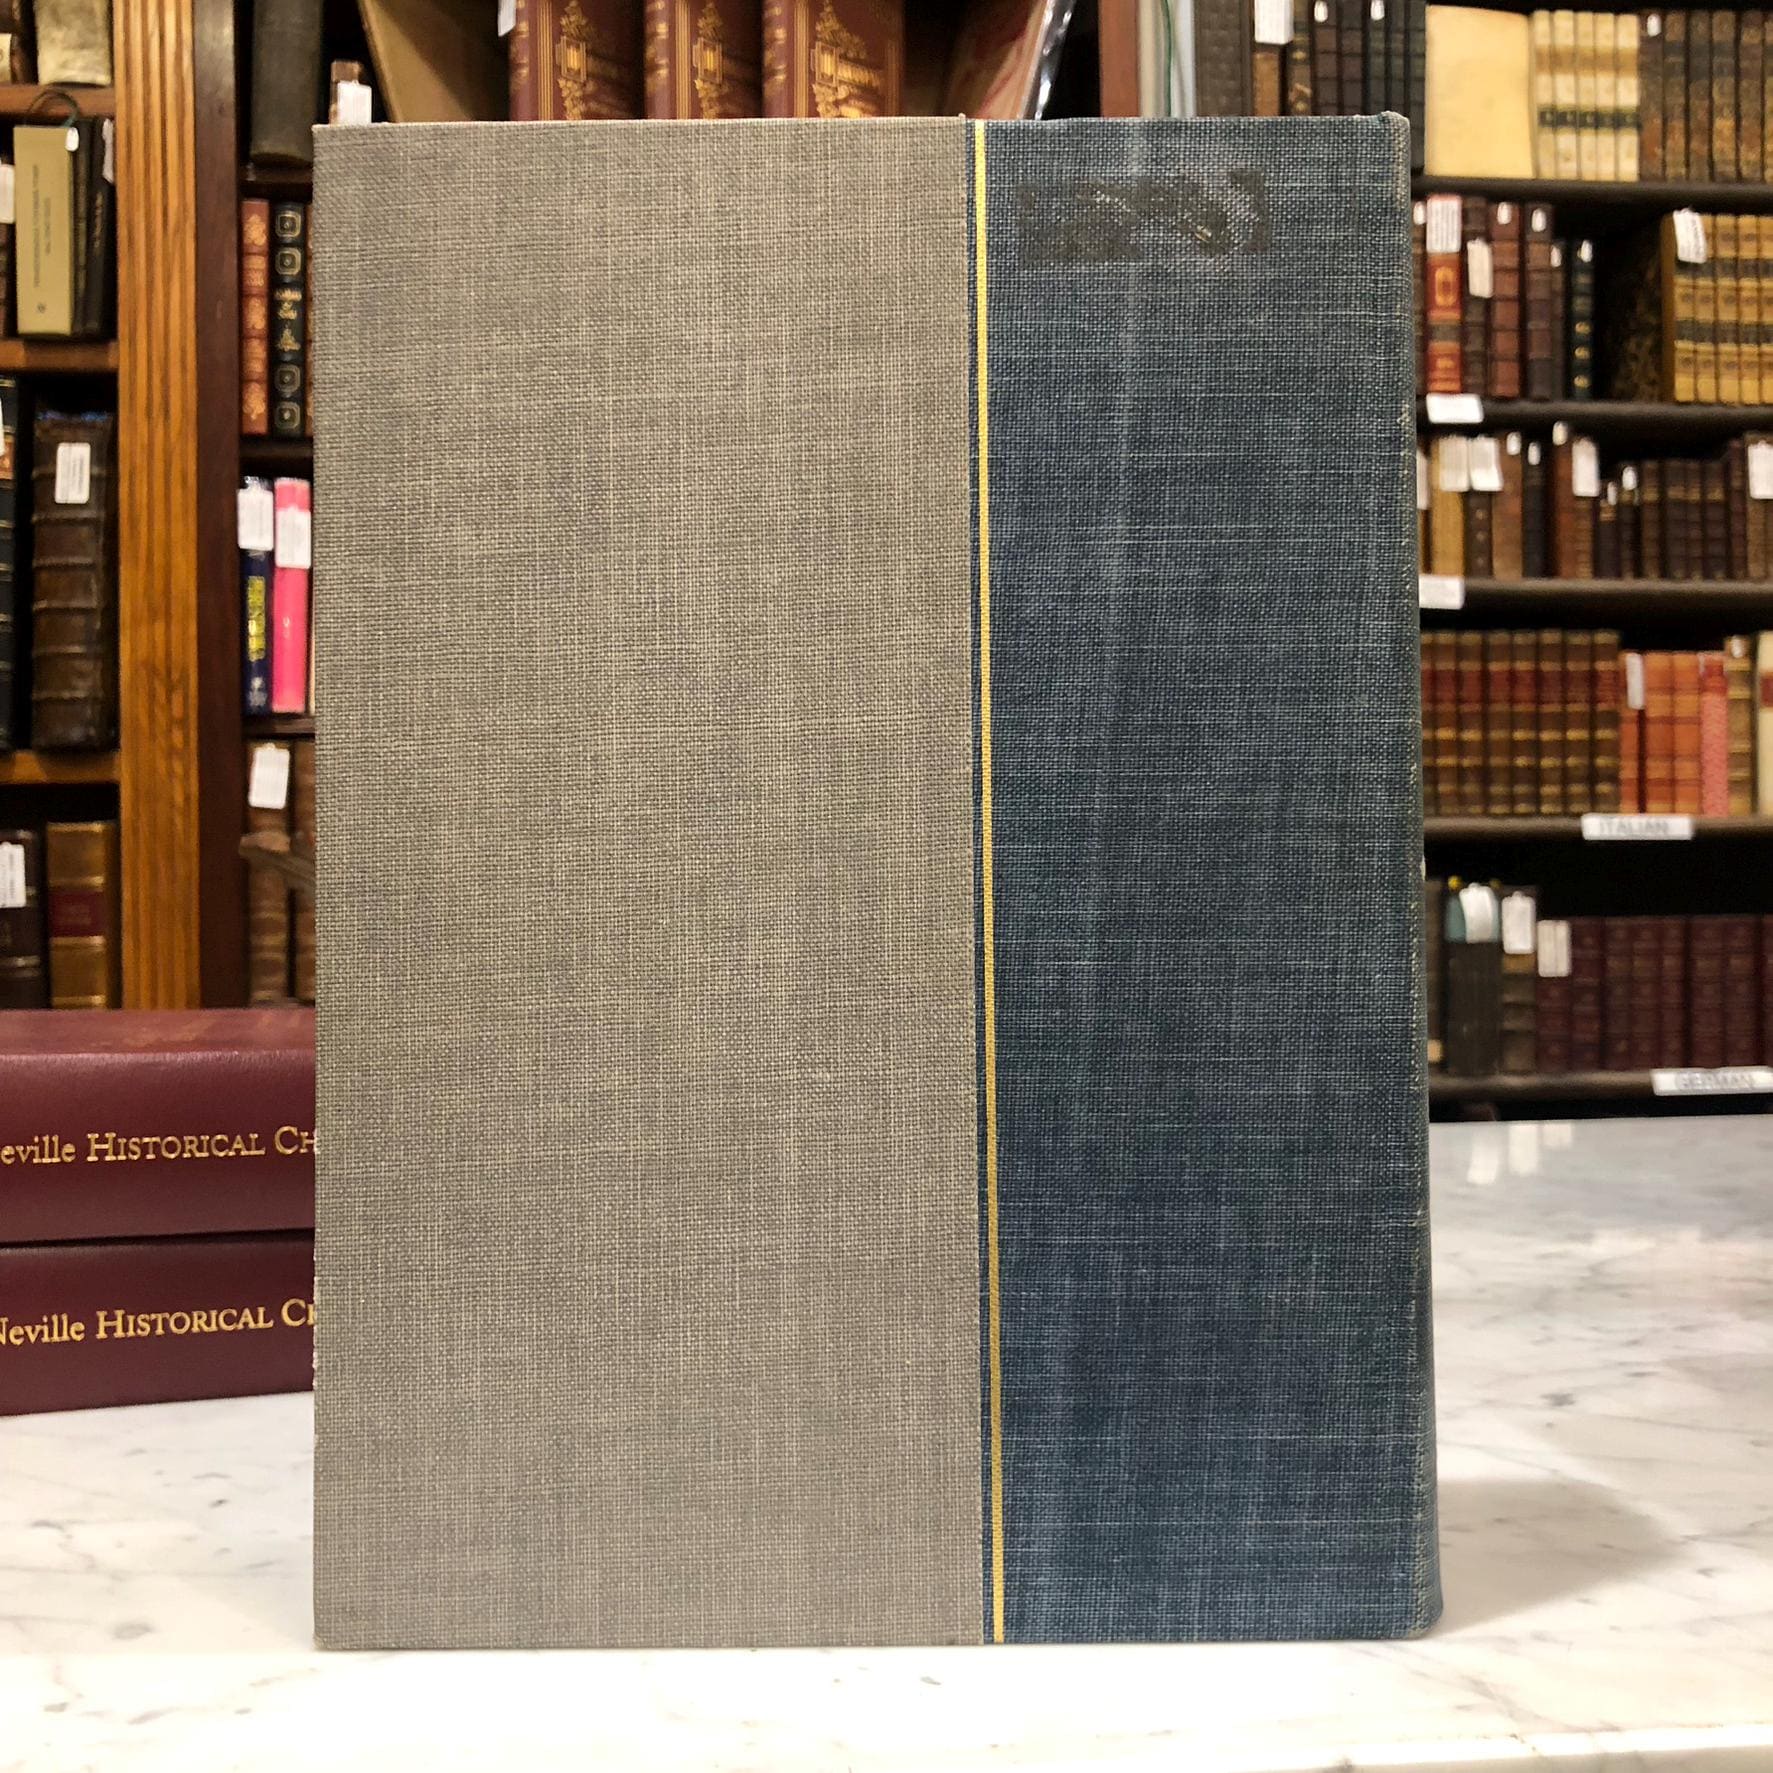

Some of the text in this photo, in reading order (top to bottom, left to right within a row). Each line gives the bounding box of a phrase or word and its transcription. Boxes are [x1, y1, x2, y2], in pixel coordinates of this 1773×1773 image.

[0, 1134, 76, 1164] eville
[86, 1132, 266, 1162] HISTORICAL
[95, 1306, 274, 1340] HISTORICAL
